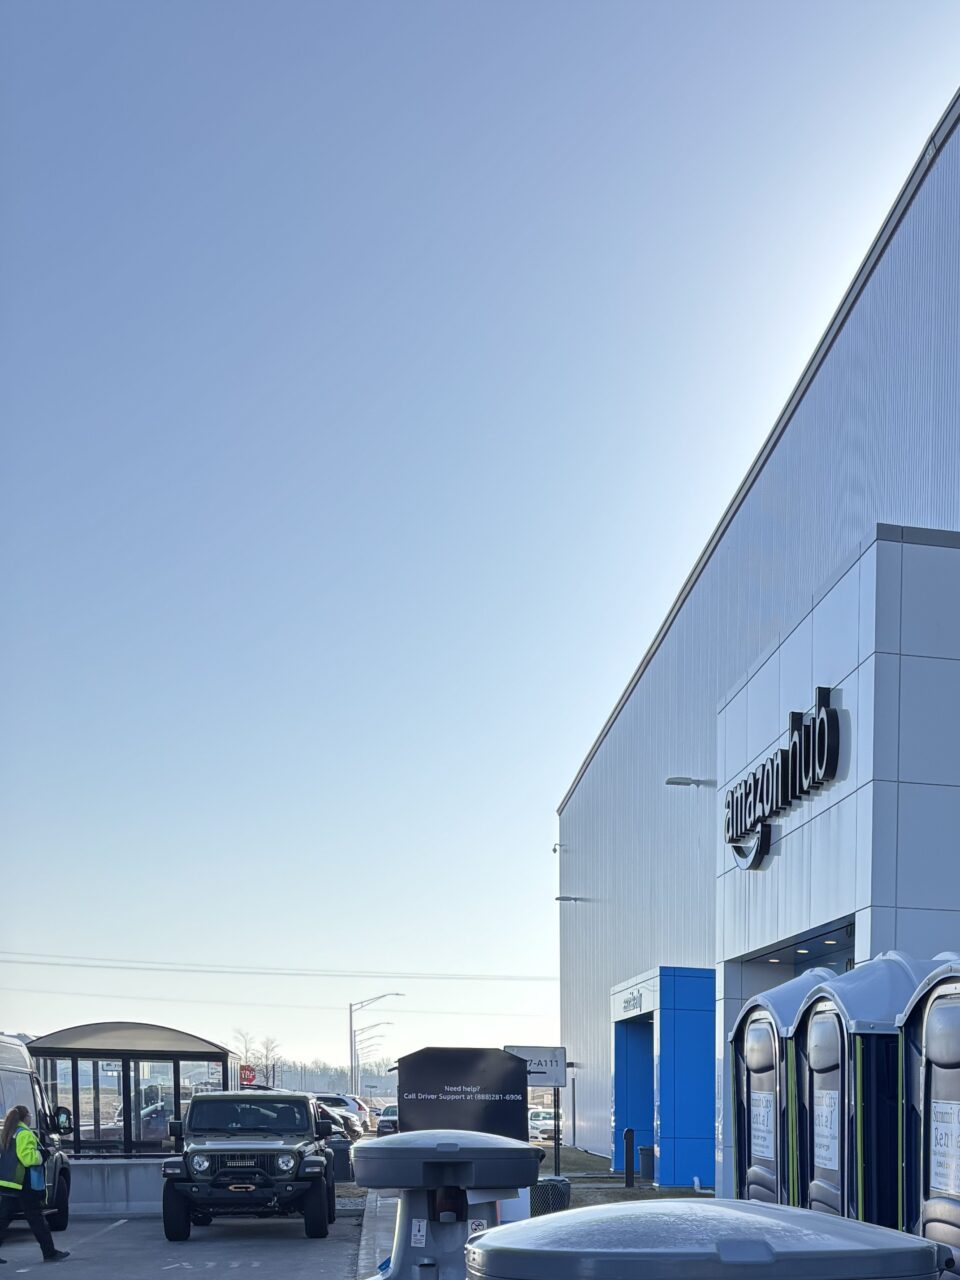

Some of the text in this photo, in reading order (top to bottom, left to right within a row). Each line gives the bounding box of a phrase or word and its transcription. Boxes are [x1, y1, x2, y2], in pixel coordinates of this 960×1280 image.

[724, 686, 839, 844] amazon hub
[462, 1085, 480, 1093] help?
[438, 1093, 466, 1101] Support
